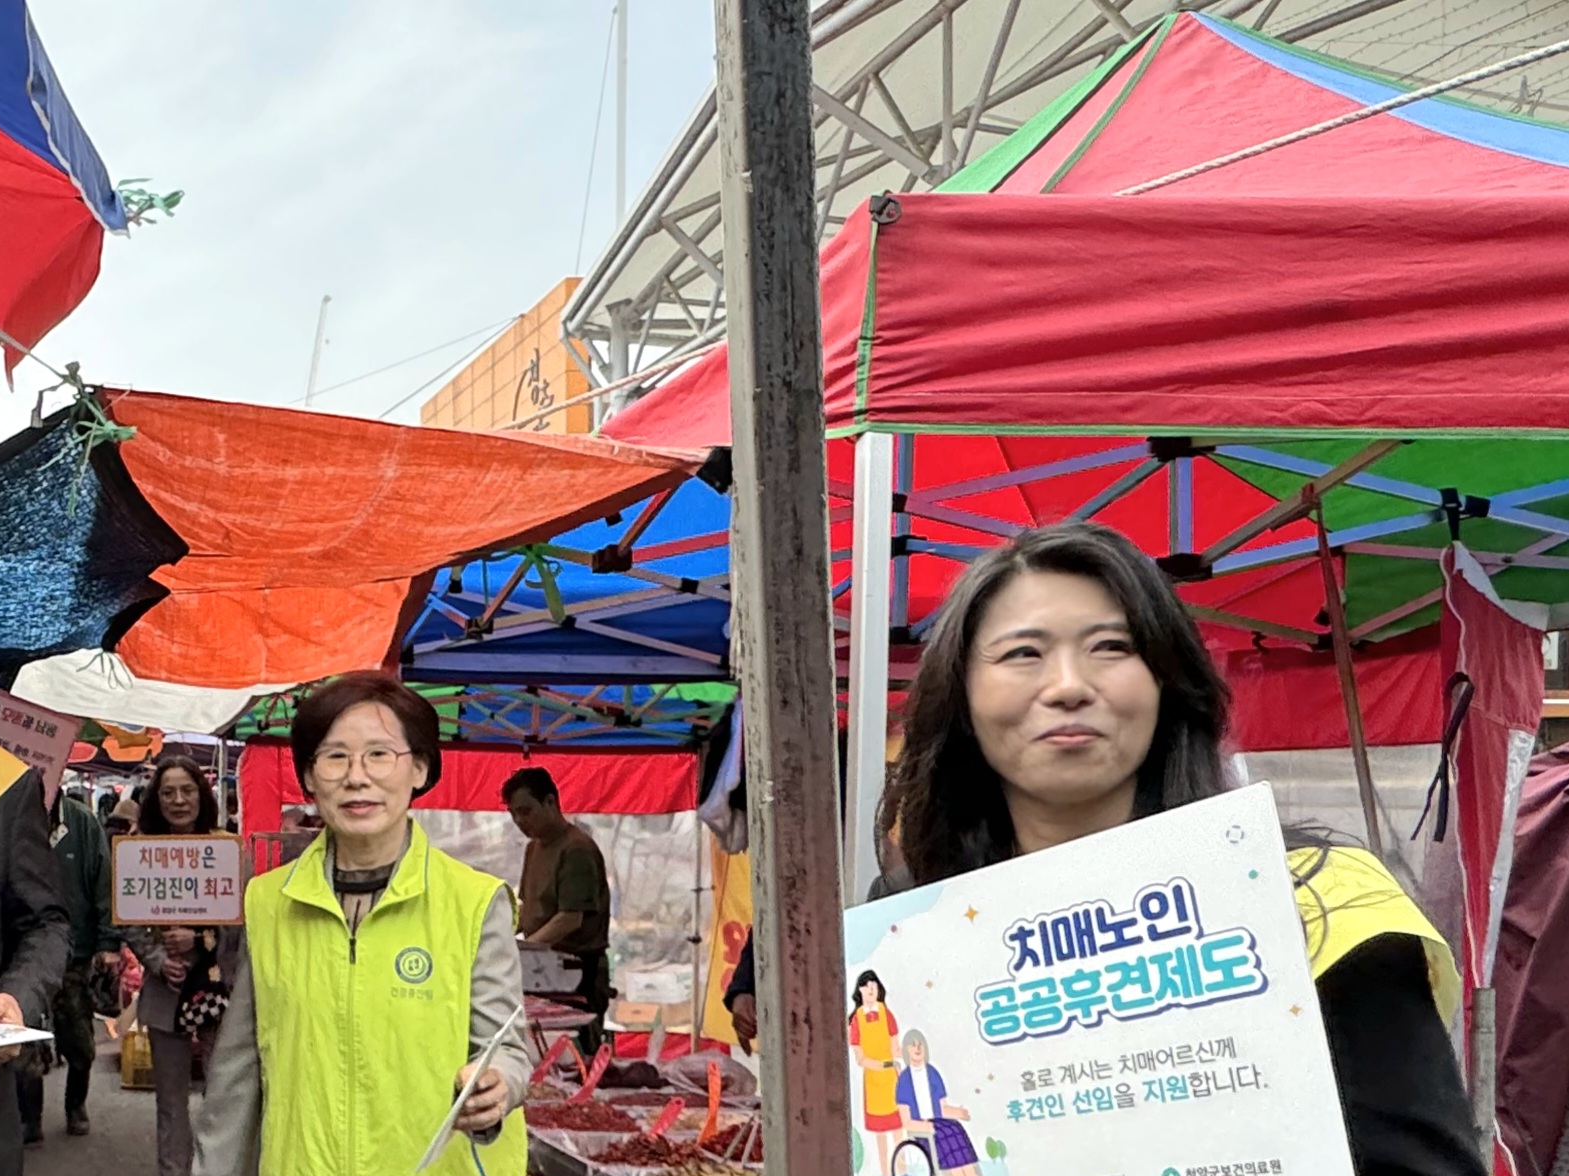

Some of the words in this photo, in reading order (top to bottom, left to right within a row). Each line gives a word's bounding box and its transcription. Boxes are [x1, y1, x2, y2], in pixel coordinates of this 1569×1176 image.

[139, 846, 216, 869] 치매예방은
[122, 877, 199, 900] 조기검진이
[204, 877, 235, 899] 최고
[1008, 884, 1192, 972] 치매노인
[978, 934, 1257, 1039] 공공후견제도
[1020, 1067, 1056, 1092] 홀로
[1058, 1060, 1113, 1085] 계시는
[1118, 1037, 1238, 1074] 치매어르신께
[1007, 1093, 1066, 1122] 후견인
[1072, 1083, 1135, 1114] 선임을
[1142, 1064, 1270, 1104] 지원합니다.
